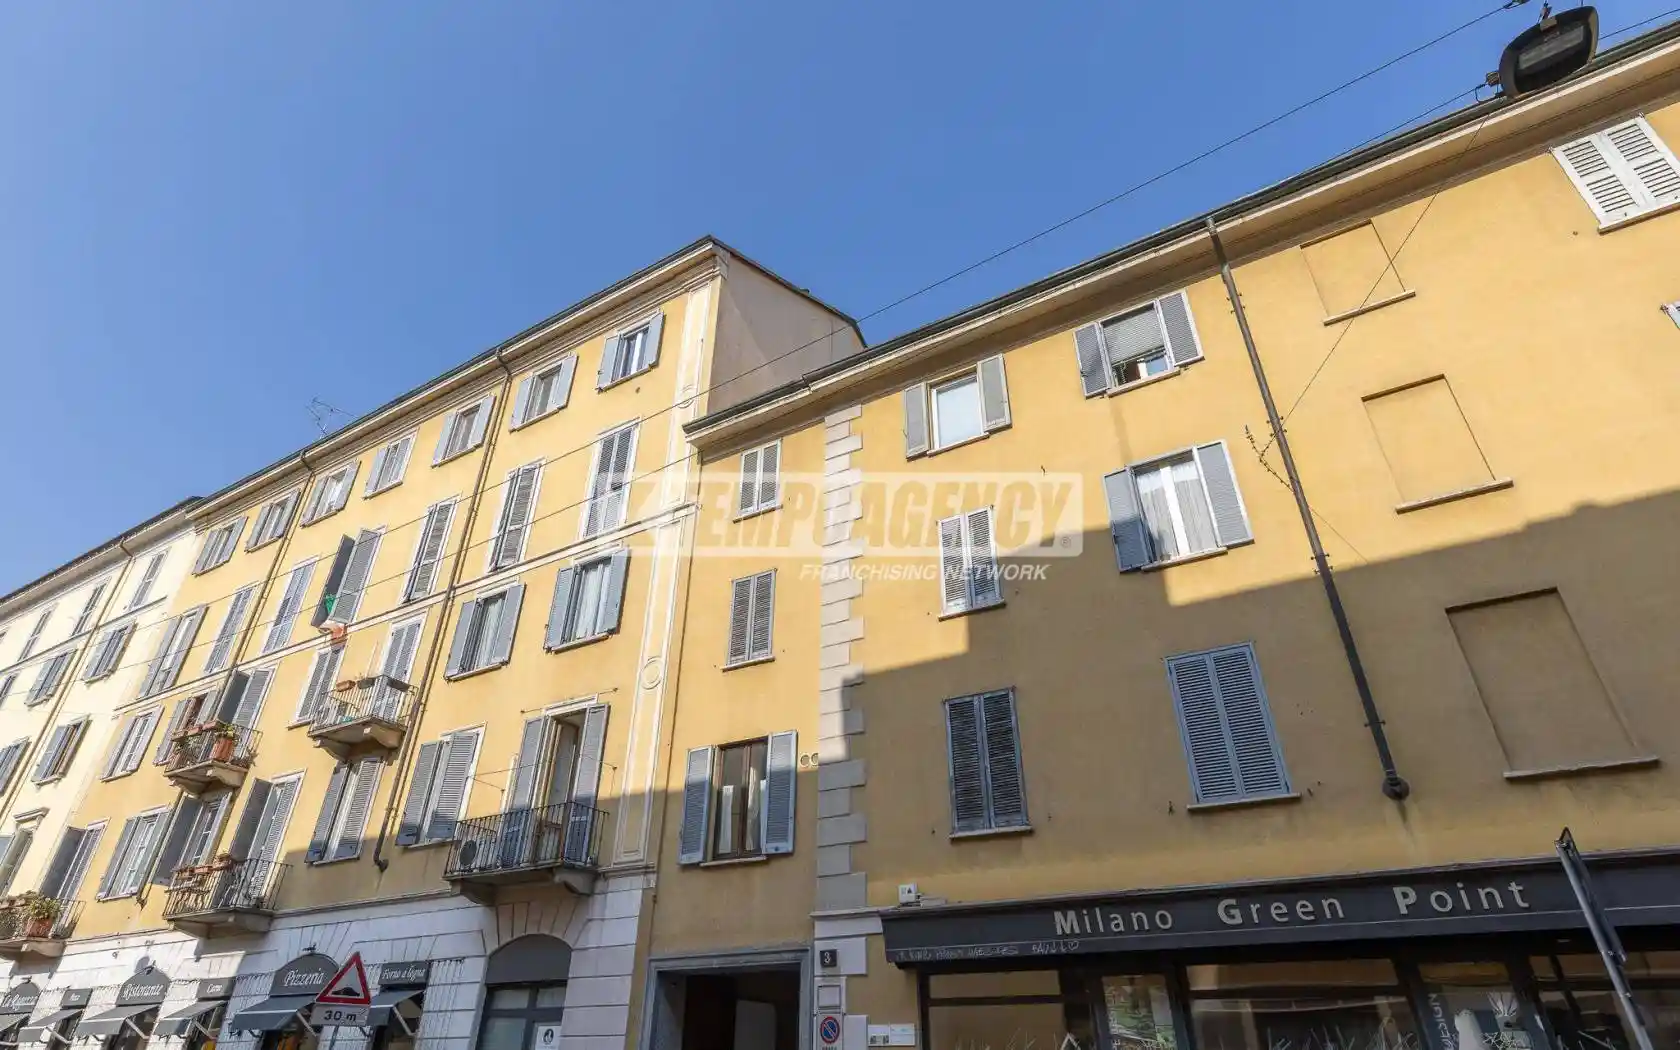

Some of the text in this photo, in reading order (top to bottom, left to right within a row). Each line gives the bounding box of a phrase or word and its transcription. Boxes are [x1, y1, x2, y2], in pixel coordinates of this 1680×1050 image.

[1053, 881, 1530, 936] Milano Green Point
[283, 967, 325, 987] Pizzeria
[122, 983, 164, 1000] Ristorante
[323, 1009, 358, 1023] 30 m
